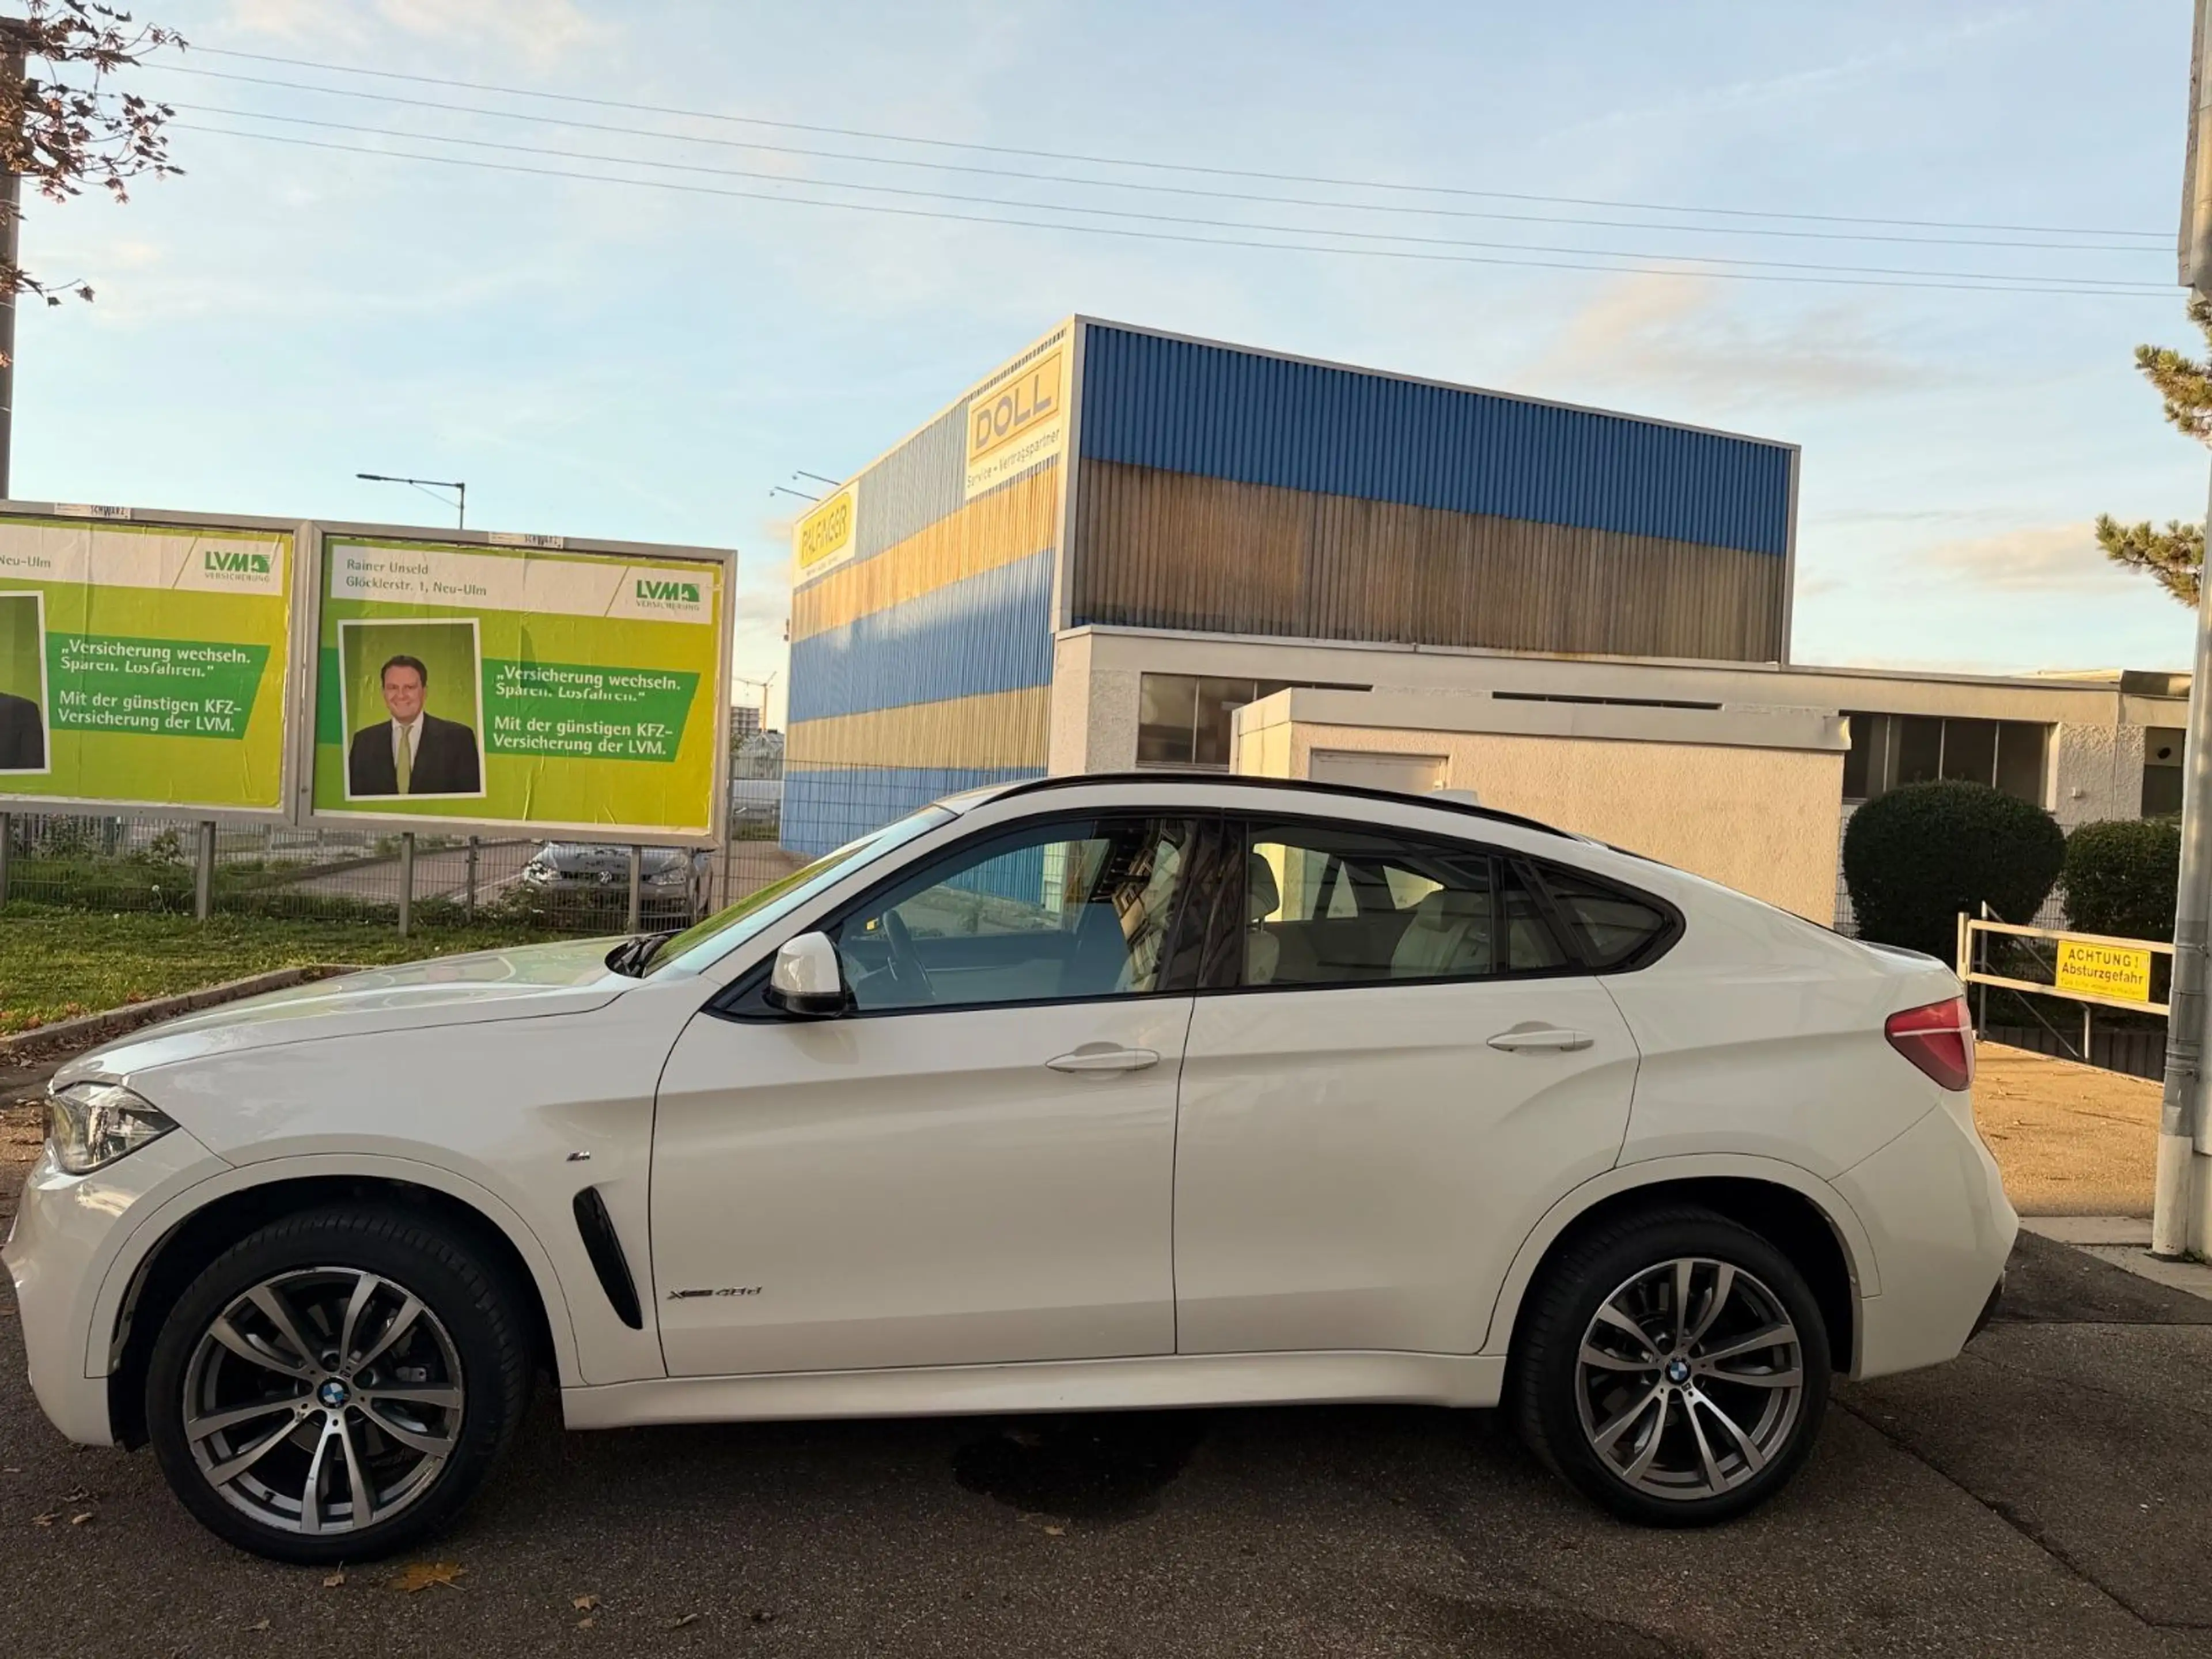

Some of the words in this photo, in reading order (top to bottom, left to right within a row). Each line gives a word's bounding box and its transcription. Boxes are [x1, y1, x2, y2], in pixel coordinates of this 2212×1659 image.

[975, 373, 1052, 450] DOLL
[999, 428, 1060, 472] Vertragspartner
[204, 551, 249, 572] LVM
[347, 558, 385, 572] Rainer
[389, 562, 429, 575] Unseld
[346, 576, 413, 591] Glöcklerstr.
[419, 581, 429, 593] 1,
[433, 581, 487, 596] Neu-Ulm
[637, 579, 679, 600] LVM
[60, 656, 119, 672] Sparen.
[177, 647, 251, 664] wechseln.
[496, 683, 552, 699] Sparen.
[609, 673, 681, 691] wechseln.
[59, 690, 87, 706] Mit
[92, 692, 118, 707] der
[123, 695, 199, 714] günstigen
[204, 699, 242, 714] KFZ-
[58, 708, 159, 730] Versicherung
[165, 715, 190, 729] der
[196, 717, 234, 733] LVM.
[494, 716, 521, 731] Mit
[527, 718, 551, 732] der
[556, 720, 631, 739] günstigen
[637, 723, 673, 738] KFZ-
[493, 733, 592, 755] Versicherung
[598, 739, 623, 753] der
[628, 740, 666, 755] LVM.
[2062, 961, 2143, 985] Absturzgefahr
